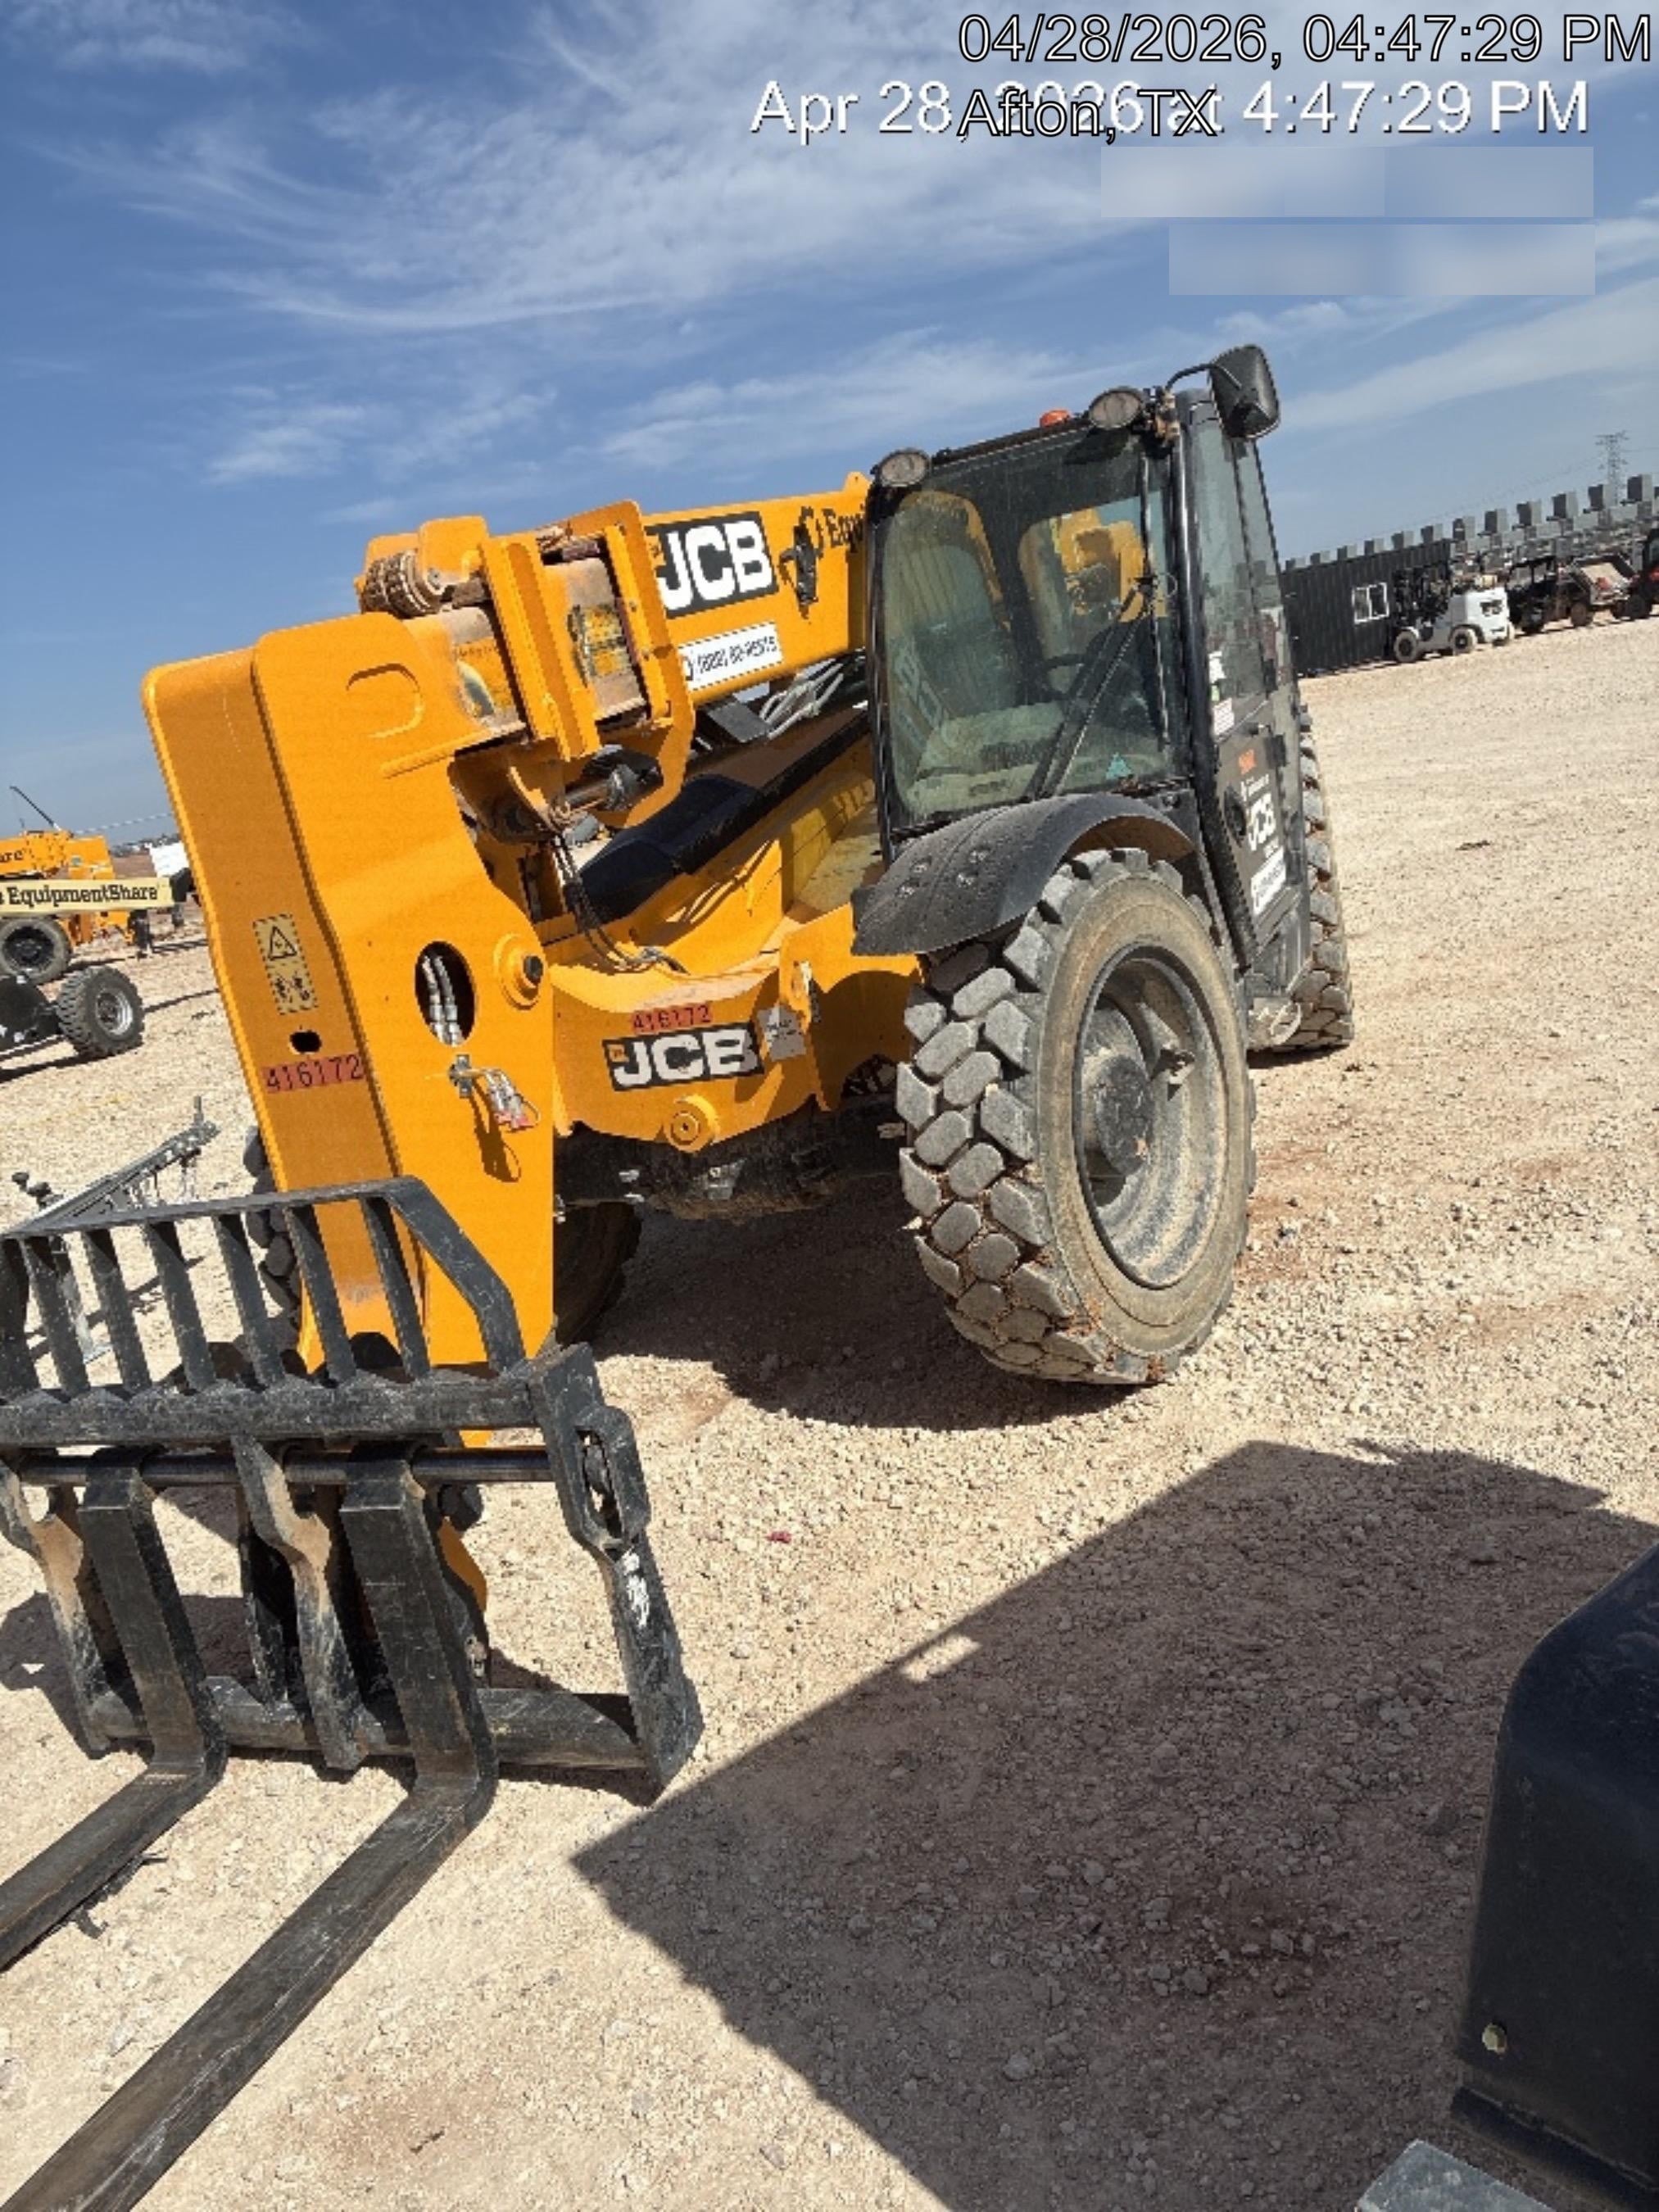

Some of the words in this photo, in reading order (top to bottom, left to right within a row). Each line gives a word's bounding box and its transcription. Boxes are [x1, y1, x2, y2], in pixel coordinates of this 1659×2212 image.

[656, 520, 773, 610] JCB
[7, 884, 158, 907] EquipmentShare
[633, 1004, 712, 1031] 416172
[266, 1054, 365, 1092] 416172
[614, 1028, 759, 1086] JCB
